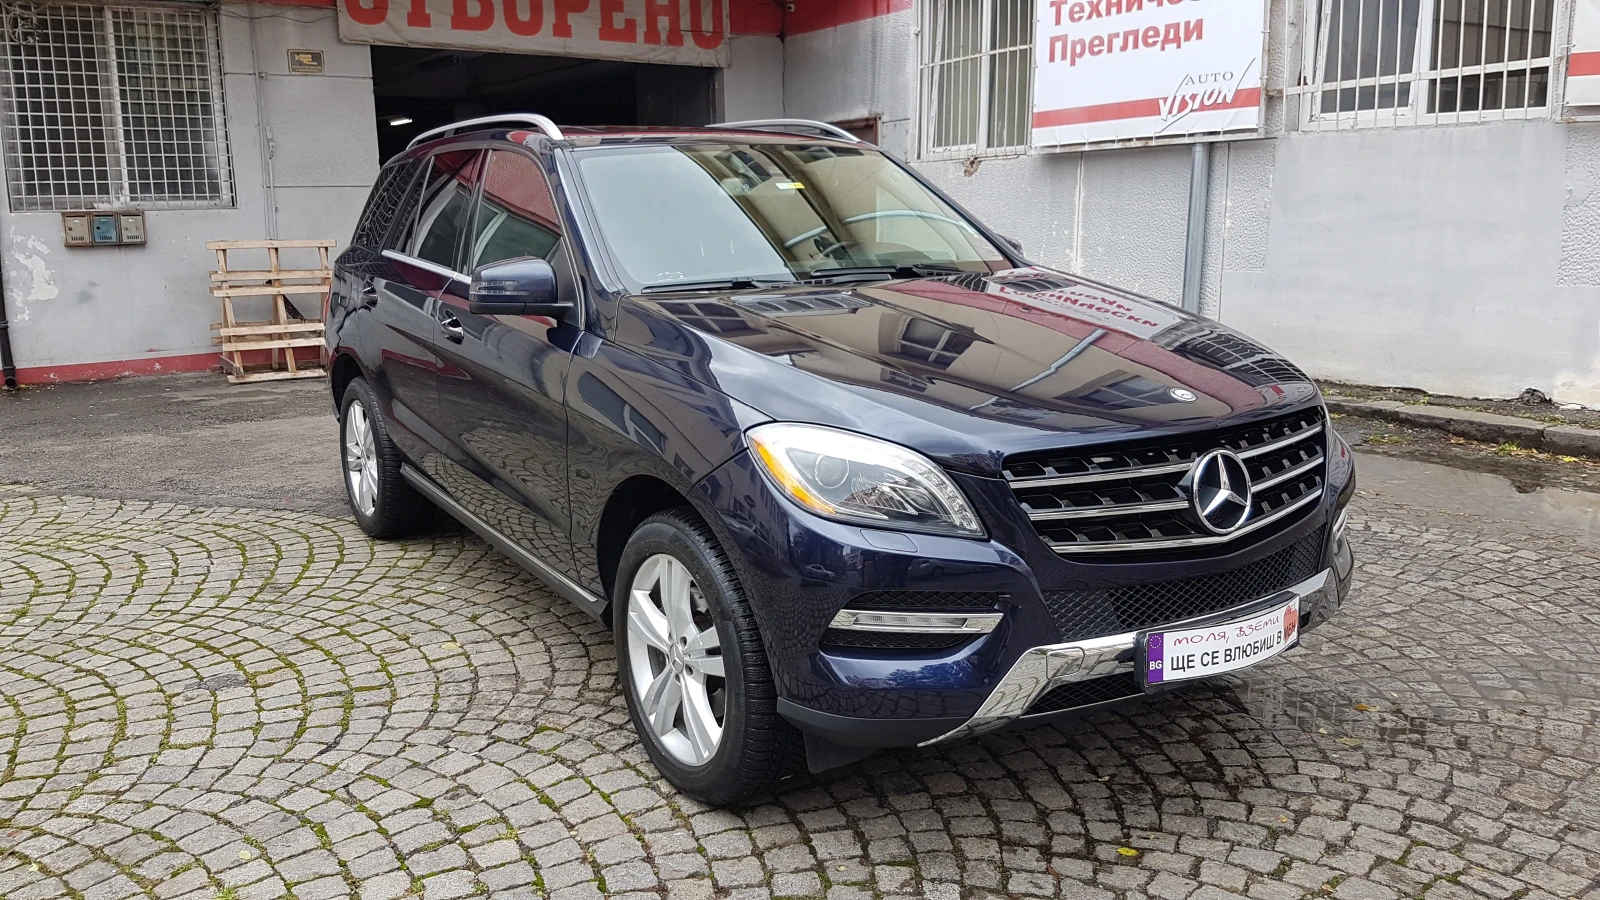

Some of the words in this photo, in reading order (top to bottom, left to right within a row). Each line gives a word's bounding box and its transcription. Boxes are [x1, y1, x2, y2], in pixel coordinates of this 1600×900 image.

[1049, 0, 1202, 26] Техни
[1049, 18, 1203, 67] Прегледи
[1185, 71, 1234, 86] AUTO
[1157, 74, 1240, 128] VISION
[1149, 660, 1162, 670] BG
[1171, 653, 1196, 673] ЩЕ
[1200, 649, 1220, 667] СЕ
[1224, 633, 1275, 663] ВЛЮБИШ
[1276, 630, 1282, 645] В
